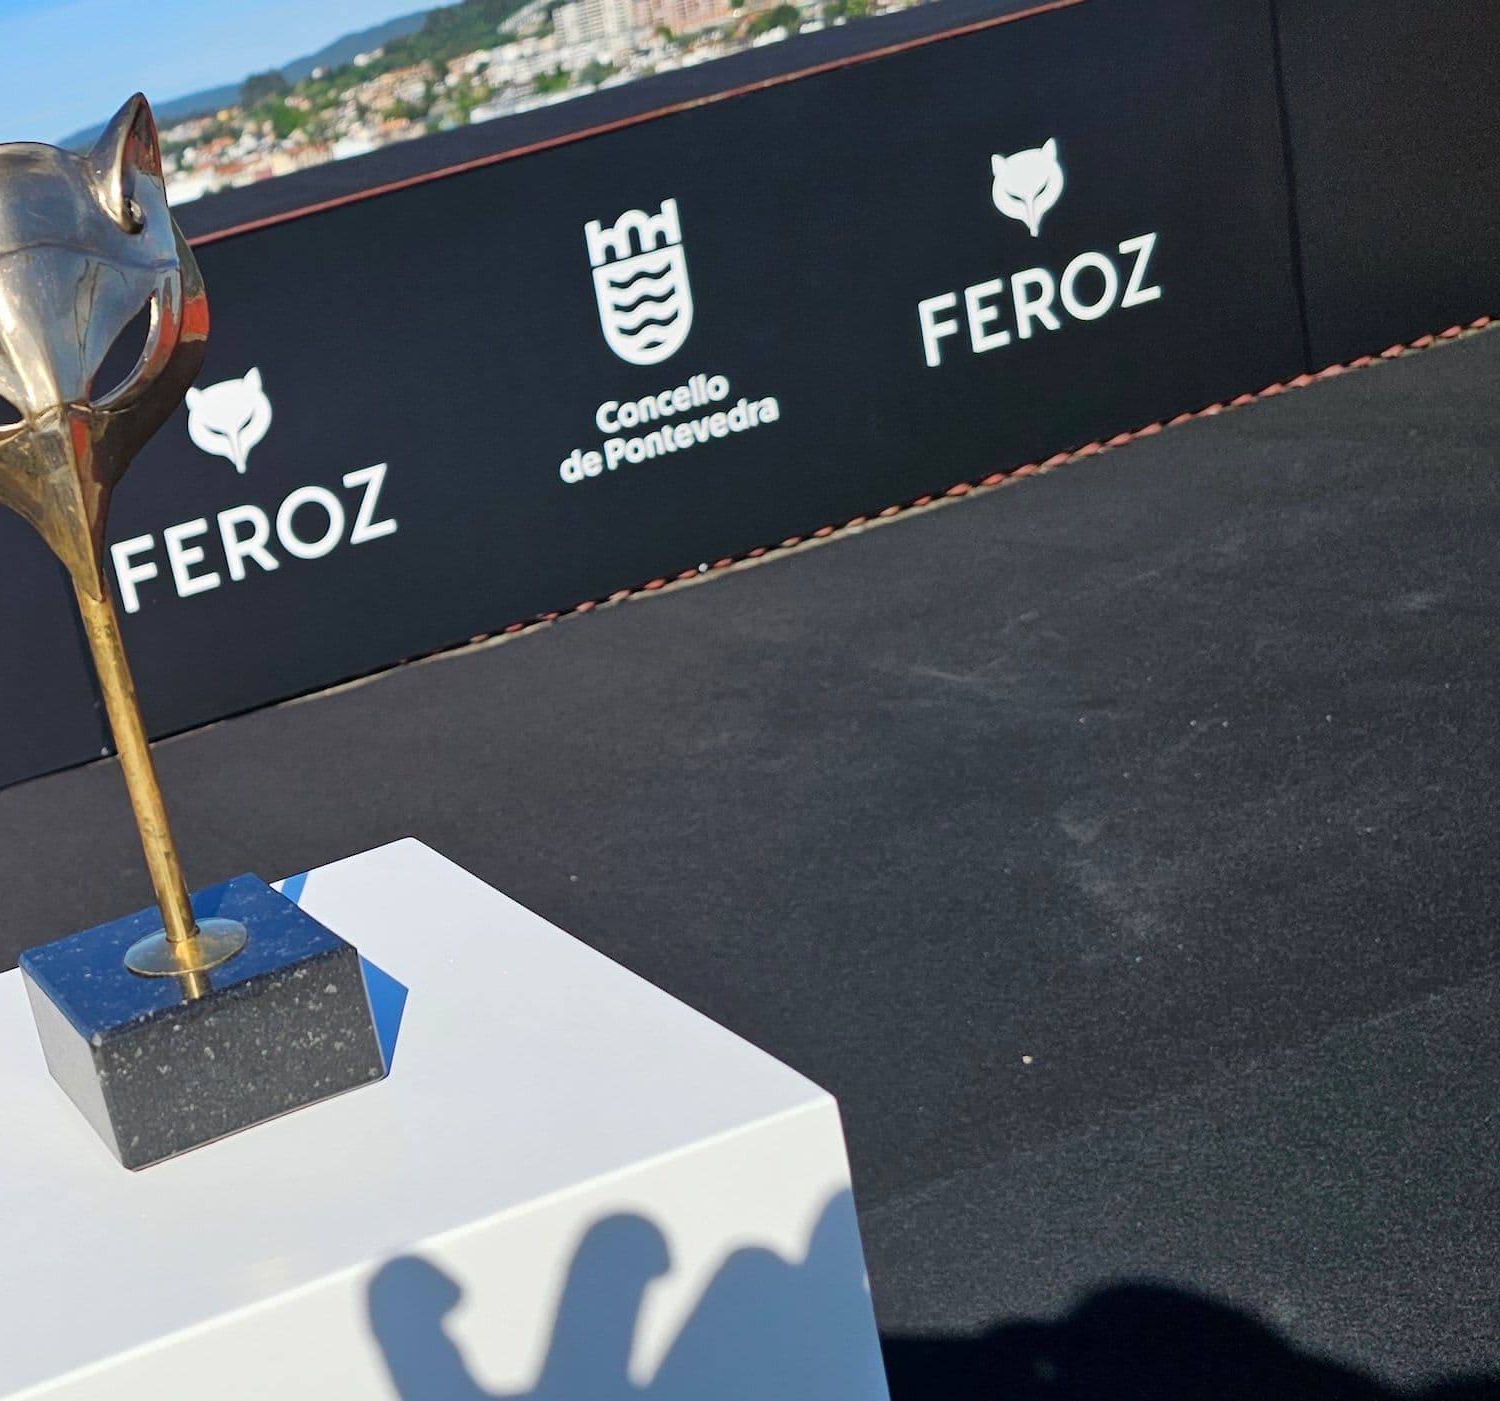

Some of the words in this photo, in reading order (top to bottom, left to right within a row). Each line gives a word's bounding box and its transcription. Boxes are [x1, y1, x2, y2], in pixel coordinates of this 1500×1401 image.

[917, 232, 1163, 369] FEROZ
[559, 447, 605, 485] de
[603, 396, 781, 472] Pontevedra
[595, 372, 731, 435] Concello
[110, 461, 399, 615] FEROZ
